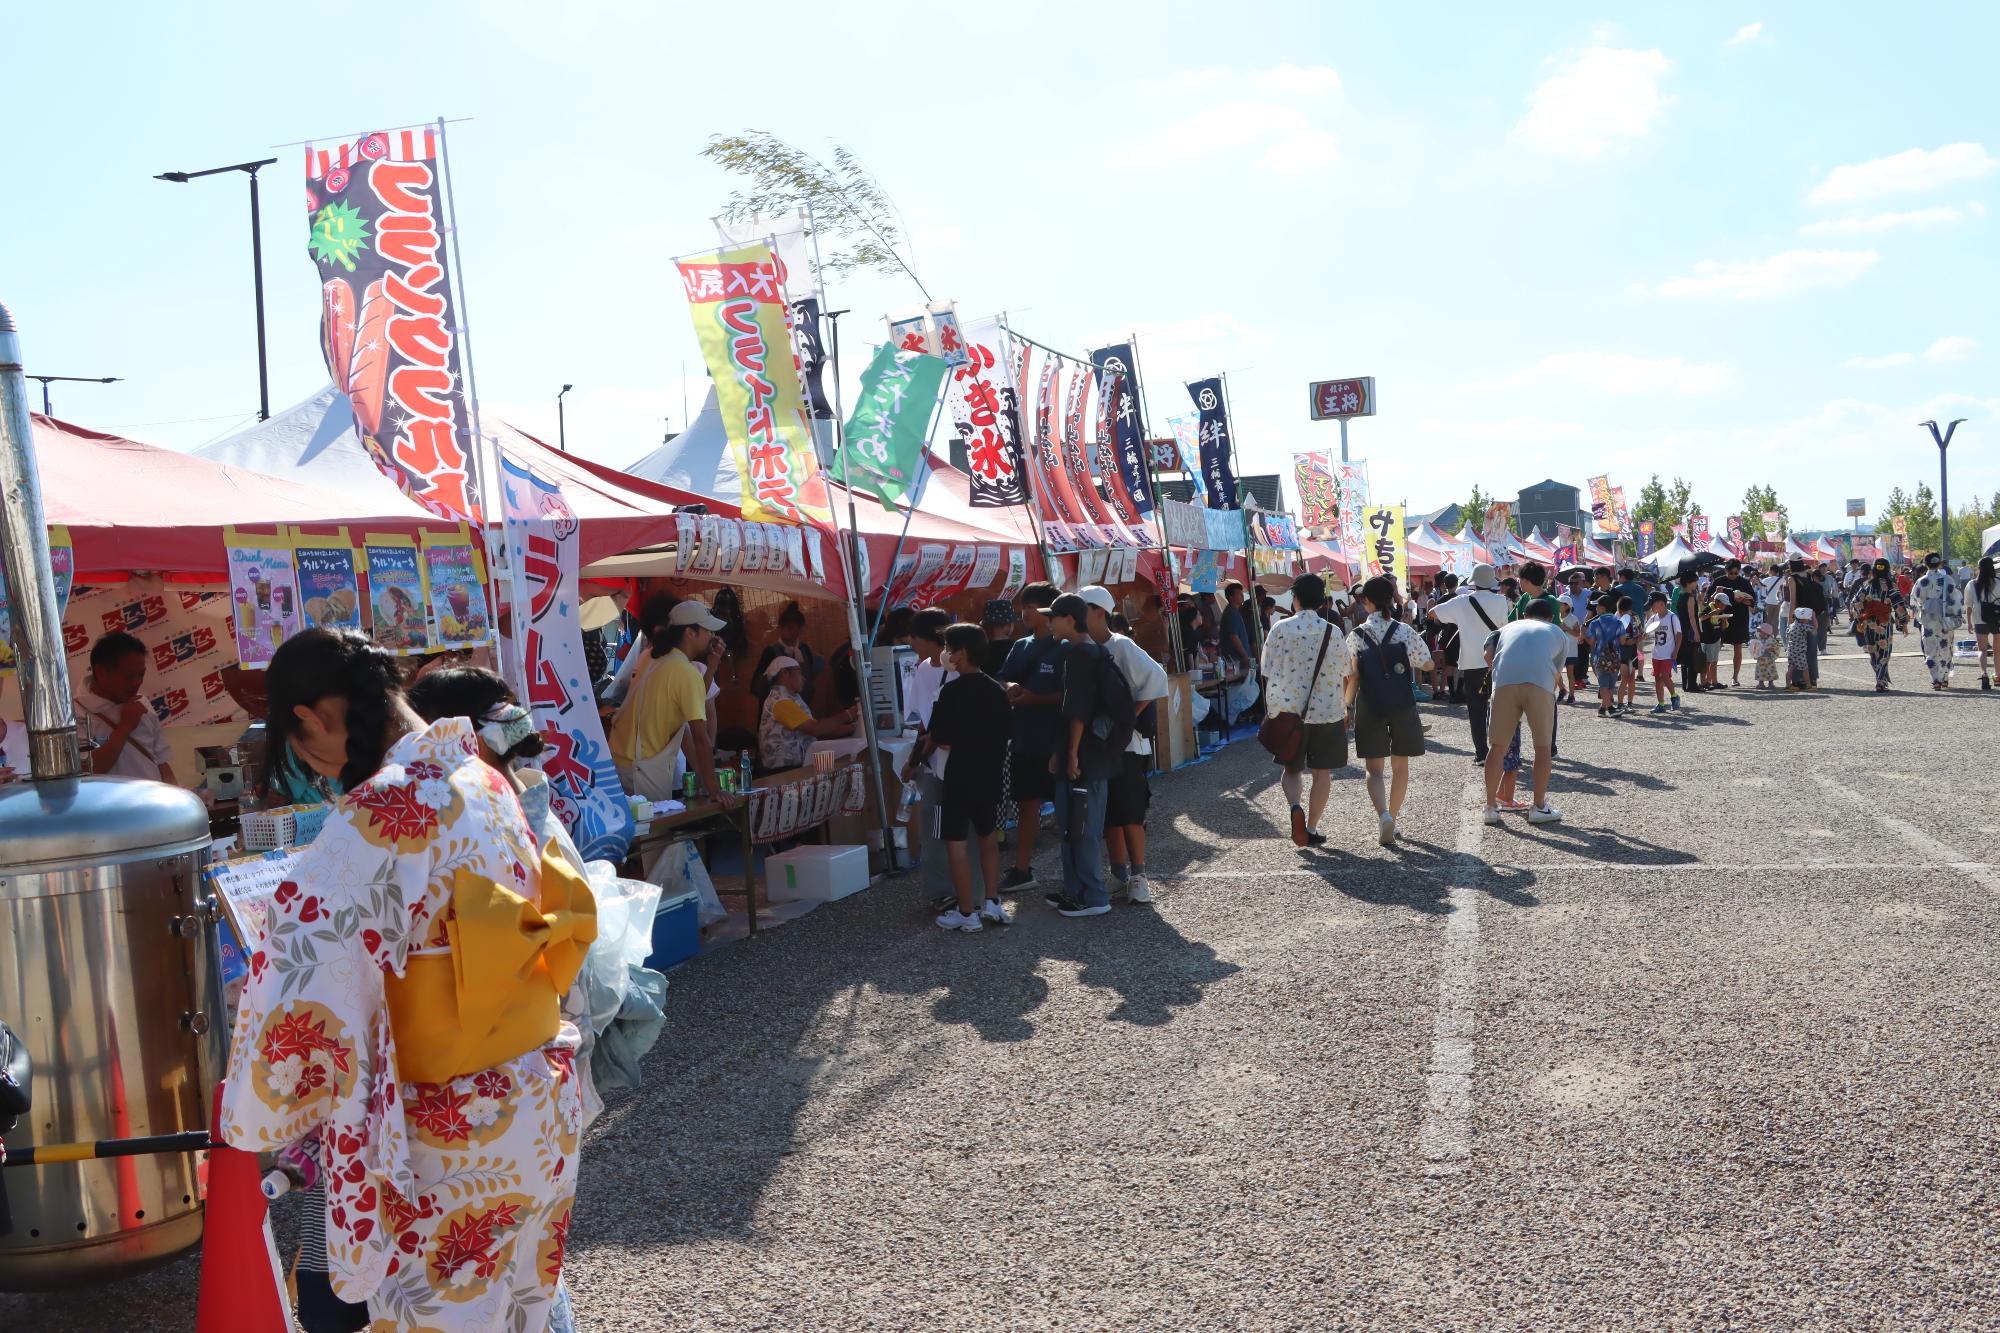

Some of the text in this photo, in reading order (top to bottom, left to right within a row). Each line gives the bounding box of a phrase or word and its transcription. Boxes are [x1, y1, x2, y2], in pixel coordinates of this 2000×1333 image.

[955, 343, 1014, 480] かき氷
[1324, 392, 1358, 414] 王将
[1200, 419, 1226, 449] 絆
[233, 549, 263, 562] Drink
[261, 558, 289, 569] Menu
[302, 558, 349, 571] カルツォーネ
[525, 534, 597, 798] ラムネ
